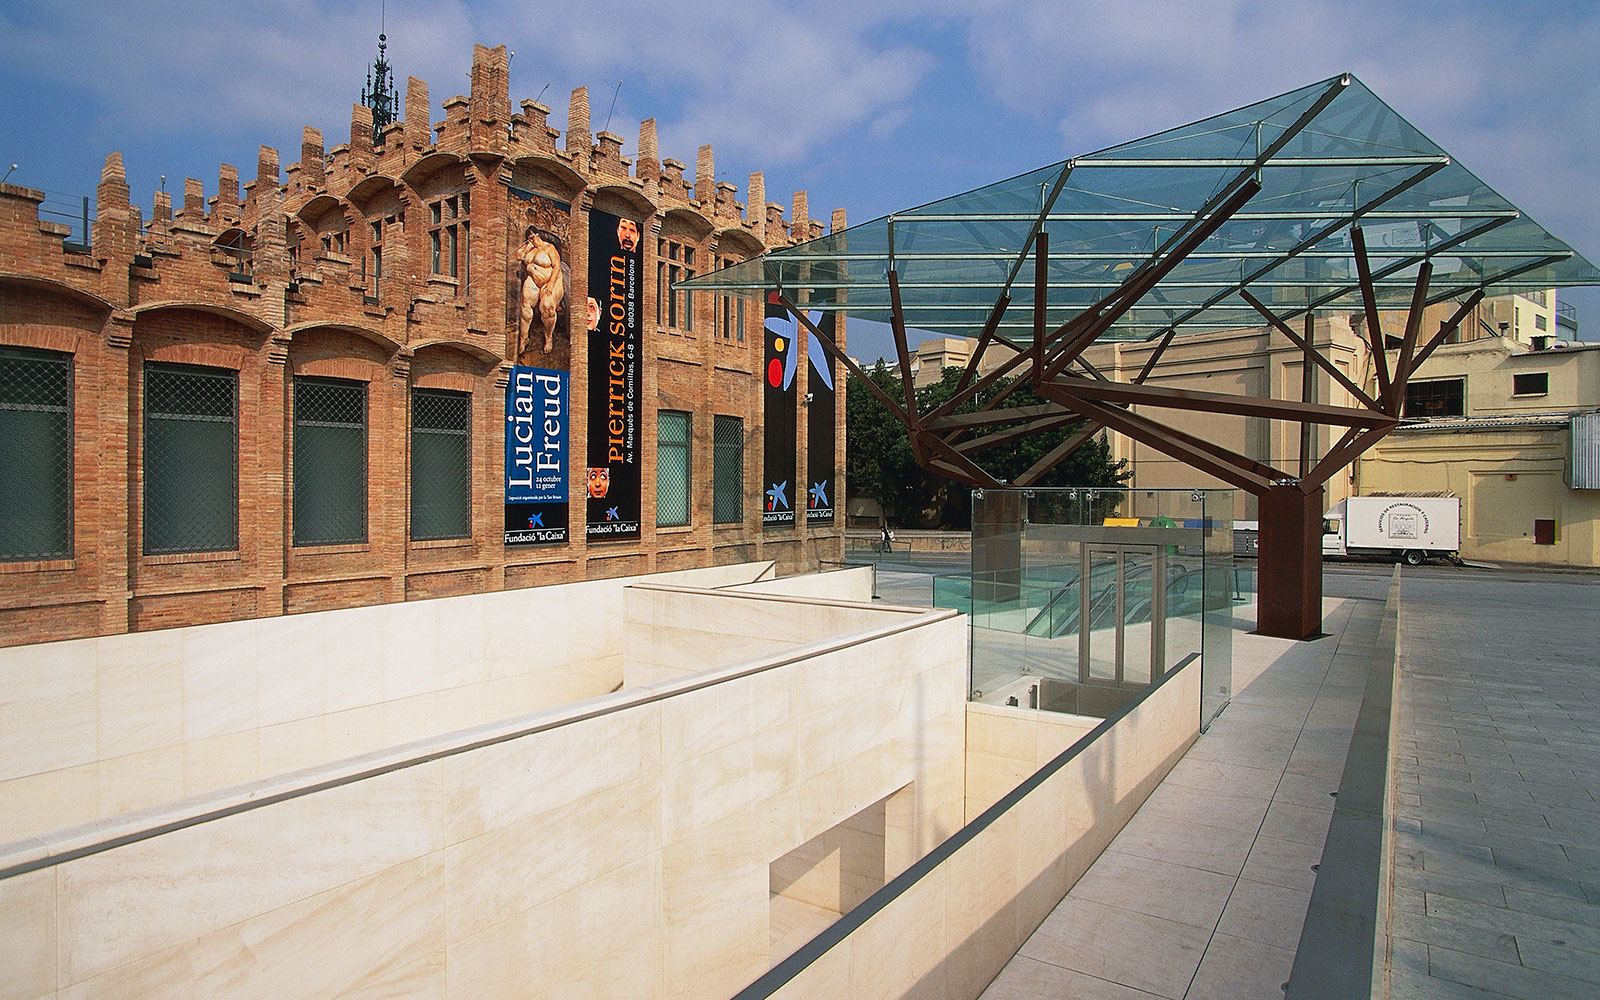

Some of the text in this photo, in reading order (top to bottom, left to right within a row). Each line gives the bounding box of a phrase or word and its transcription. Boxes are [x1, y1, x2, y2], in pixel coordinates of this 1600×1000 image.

[627, 259, 636, 300] Barcelona
[627, 301, 635, 328] 08038
[626, 361, 635, 399] Comillas,
[627, 401, 634, 412] de
[508, 372, 534, 489] Lucian
[535, 374, 561, 473] Freud
[504, 532, 536, 543] Fundació
[545, 530, 566, 541] Caixa"
[585, 524, 613, 534] Fundació
